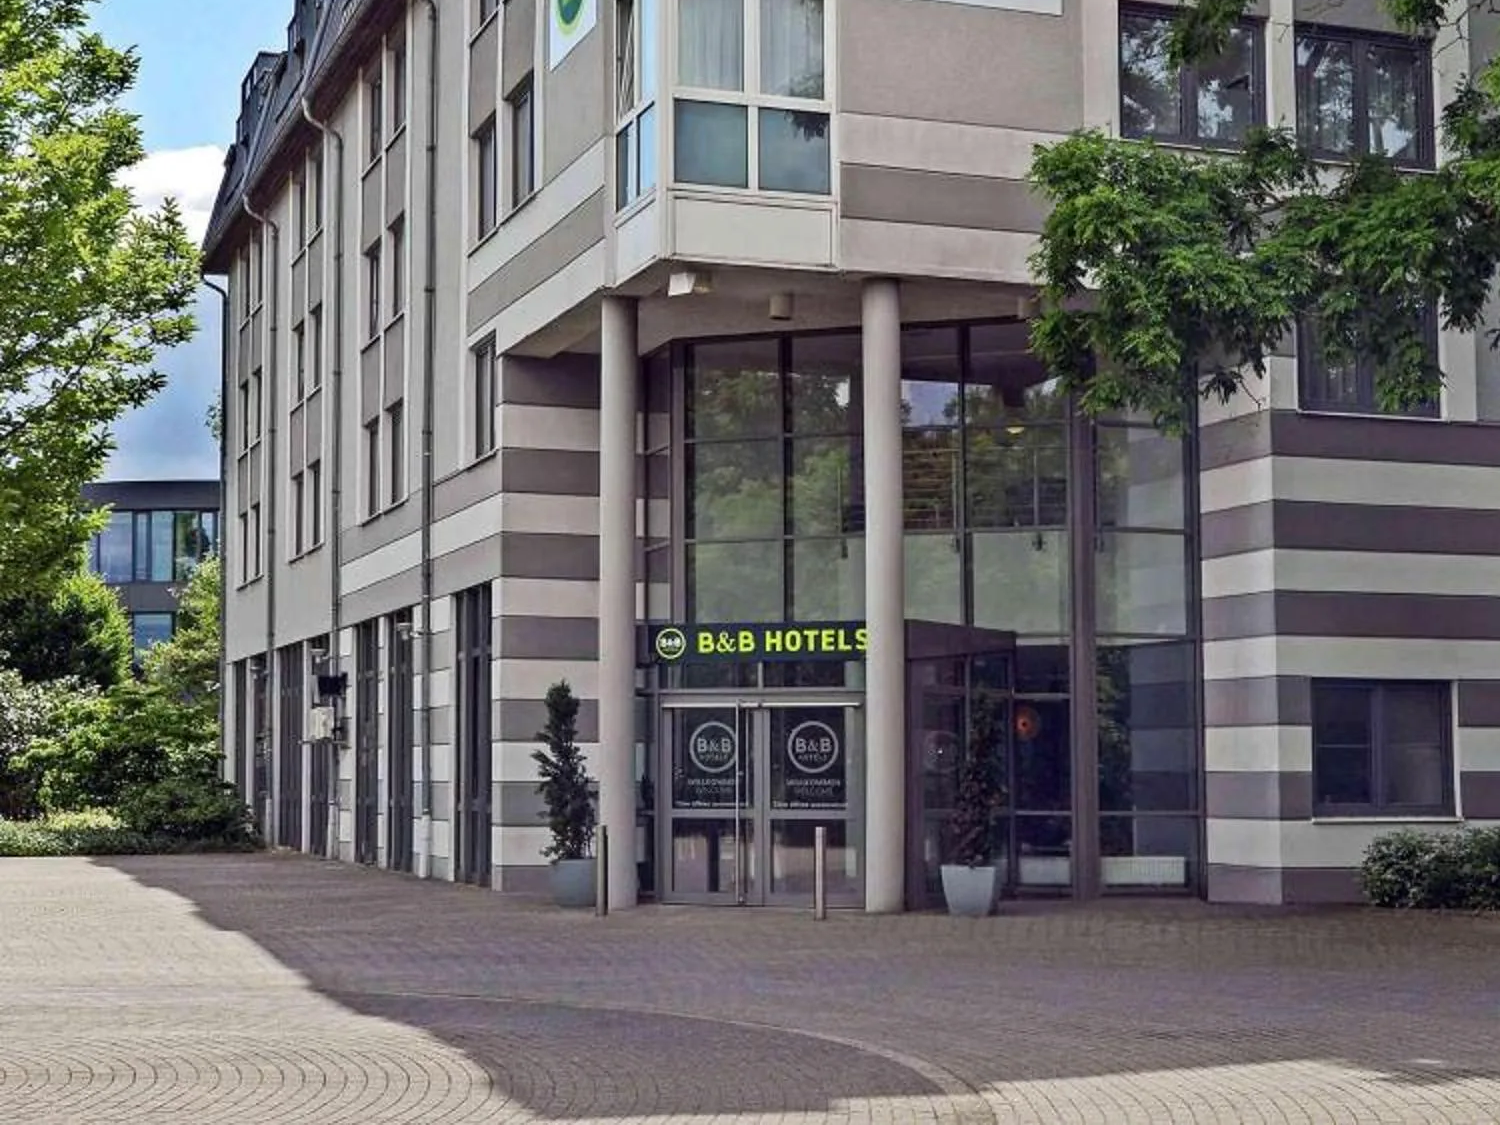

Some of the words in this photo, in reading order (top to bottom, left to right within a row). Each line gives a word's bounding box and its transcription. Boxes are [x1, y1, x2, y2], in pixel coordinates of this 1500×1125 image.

[698, 630, 755, 653] B&B
[765, 628, 868, 652] HOTELS
[697, 738, 731, 753] B&B
[795, 738, 832, 753] B&B
